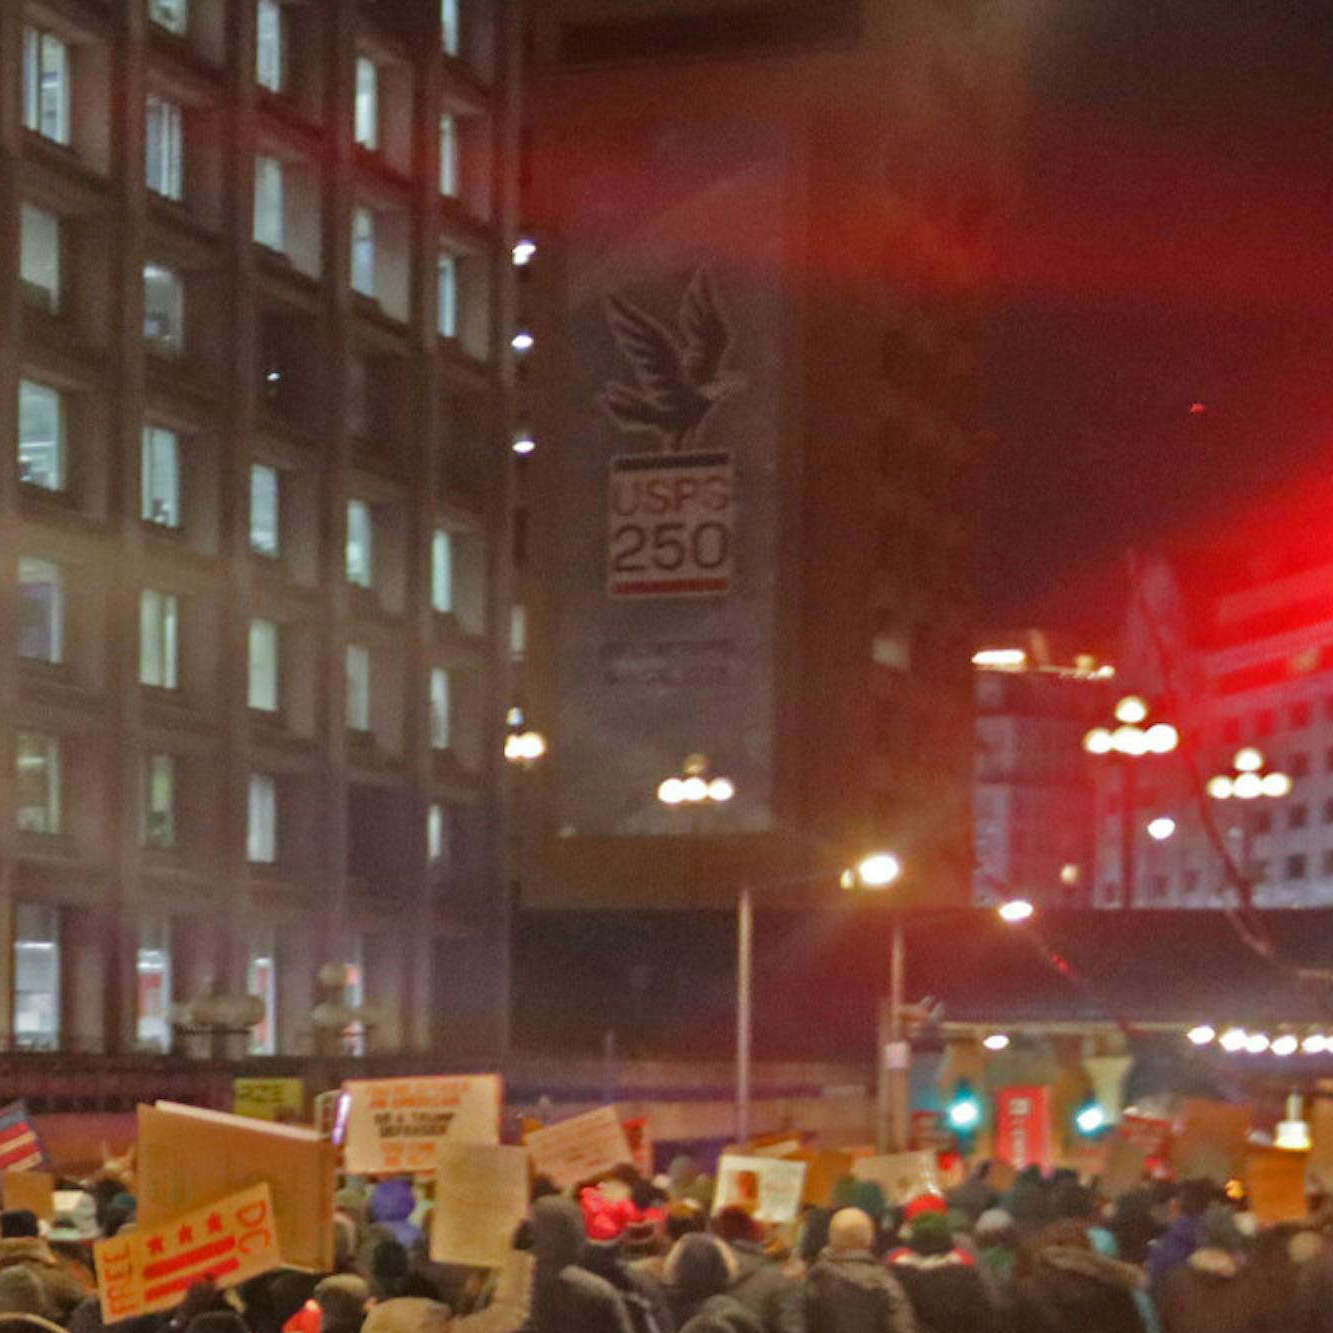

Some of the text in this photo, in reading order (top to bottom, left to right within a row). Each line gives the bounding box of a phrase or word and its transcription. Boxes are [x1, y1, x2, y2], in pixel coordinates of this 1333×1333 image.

[612, 476, 728, 516] USPS
[614, 521, 729, 572] 250
[236, 1199, 271, 1254] DC
[102, 1242, 137, 1316] FREE
